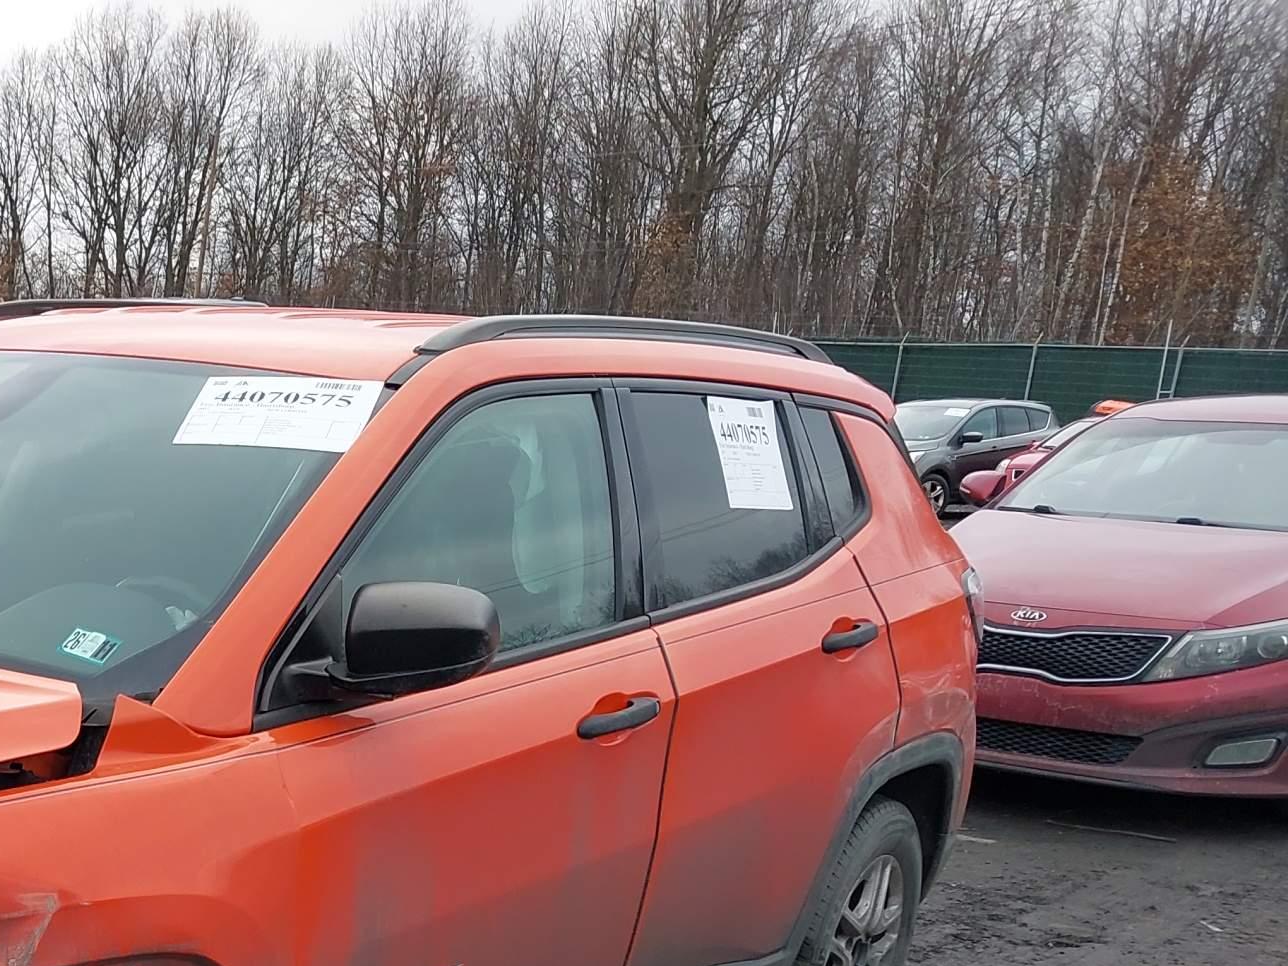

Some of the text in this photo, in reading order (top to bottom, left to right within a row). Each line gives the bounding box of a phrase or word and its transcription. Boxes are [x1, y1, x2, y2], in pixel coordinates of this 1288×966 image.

[214, 389, 355, 408] 44070575
[719, 421, 770, 446] 44070575
[63, 630, 87, 650] 26
